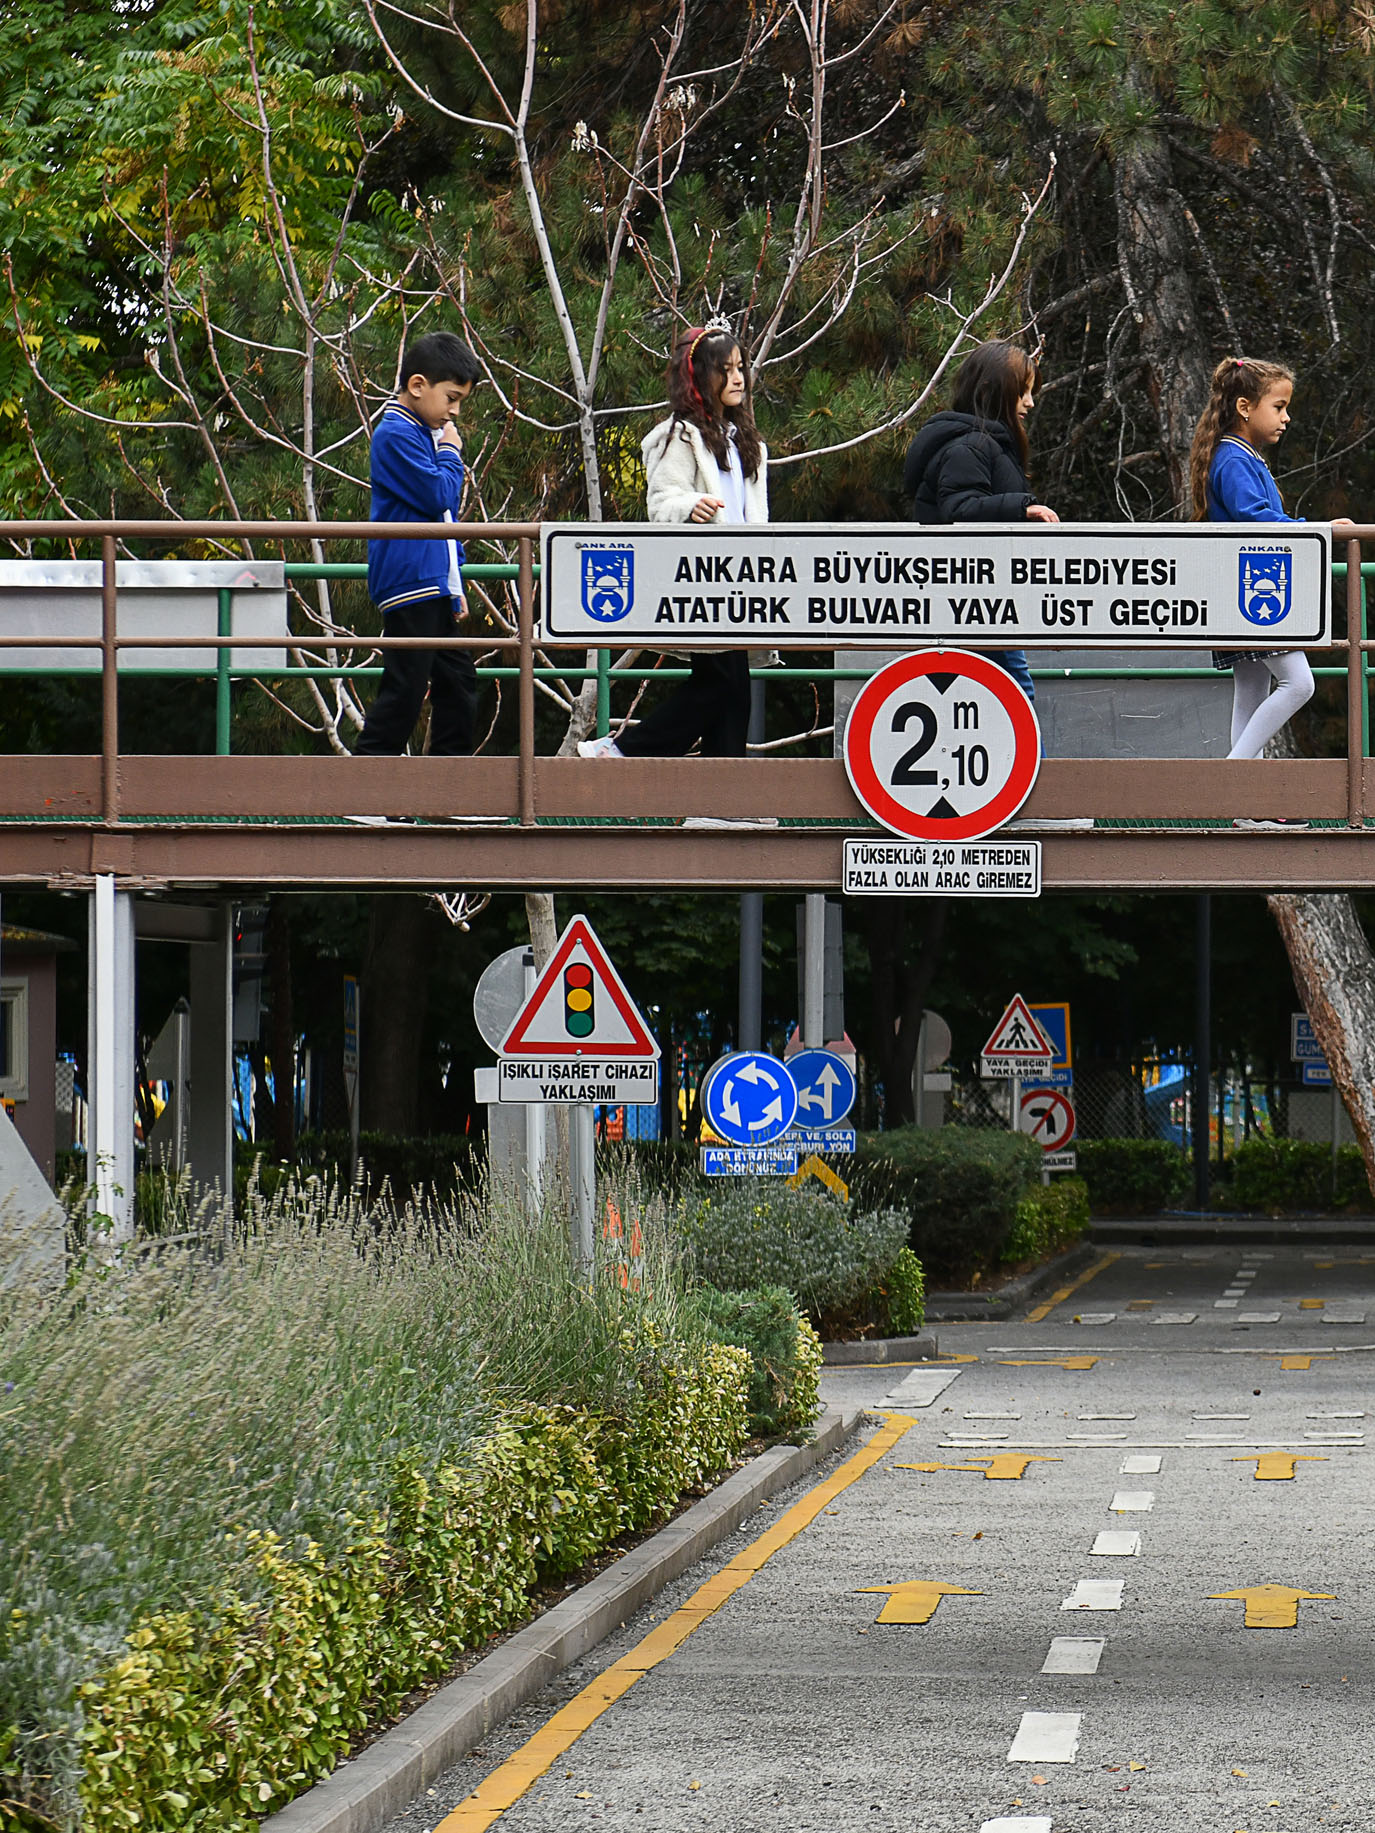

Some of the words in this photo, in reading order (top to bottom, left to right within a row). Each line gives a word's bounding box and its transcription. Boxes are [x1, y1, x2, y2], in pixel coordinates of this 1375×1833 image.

[674, 555, 798, 584] ANKARA
[654, 590, 790, 624] ATATÜRK
[807, 597, 931, 625] BULVARI
[947, 598, 1019, 625] YAYA
[1041, 593, 1093, 627] ÜST
[932, 849, 955, 868] 2,10
[961, 849, 1031, 866] METREDEN
[848, 871, 888, 888] FAZLA
[894, 871, 929, 888] OLAN
[935, 871, 970, 889] ARAC
[986, 1059, 1010, 1067] YAYA
[503, 1064, 544, 1080] IŞIKLI
[990, 1068, 1043, 1078] YAKLAŞIMI
[539, 1084, 616, 1102] YAKLAŞIMI
[806, 1132, 820, 1141] VE
[825, 1132, 853, 1141] SOLA
[829, 1141, 851, 1151] YÖN
[708, 1151, 731, 1162] ADA
